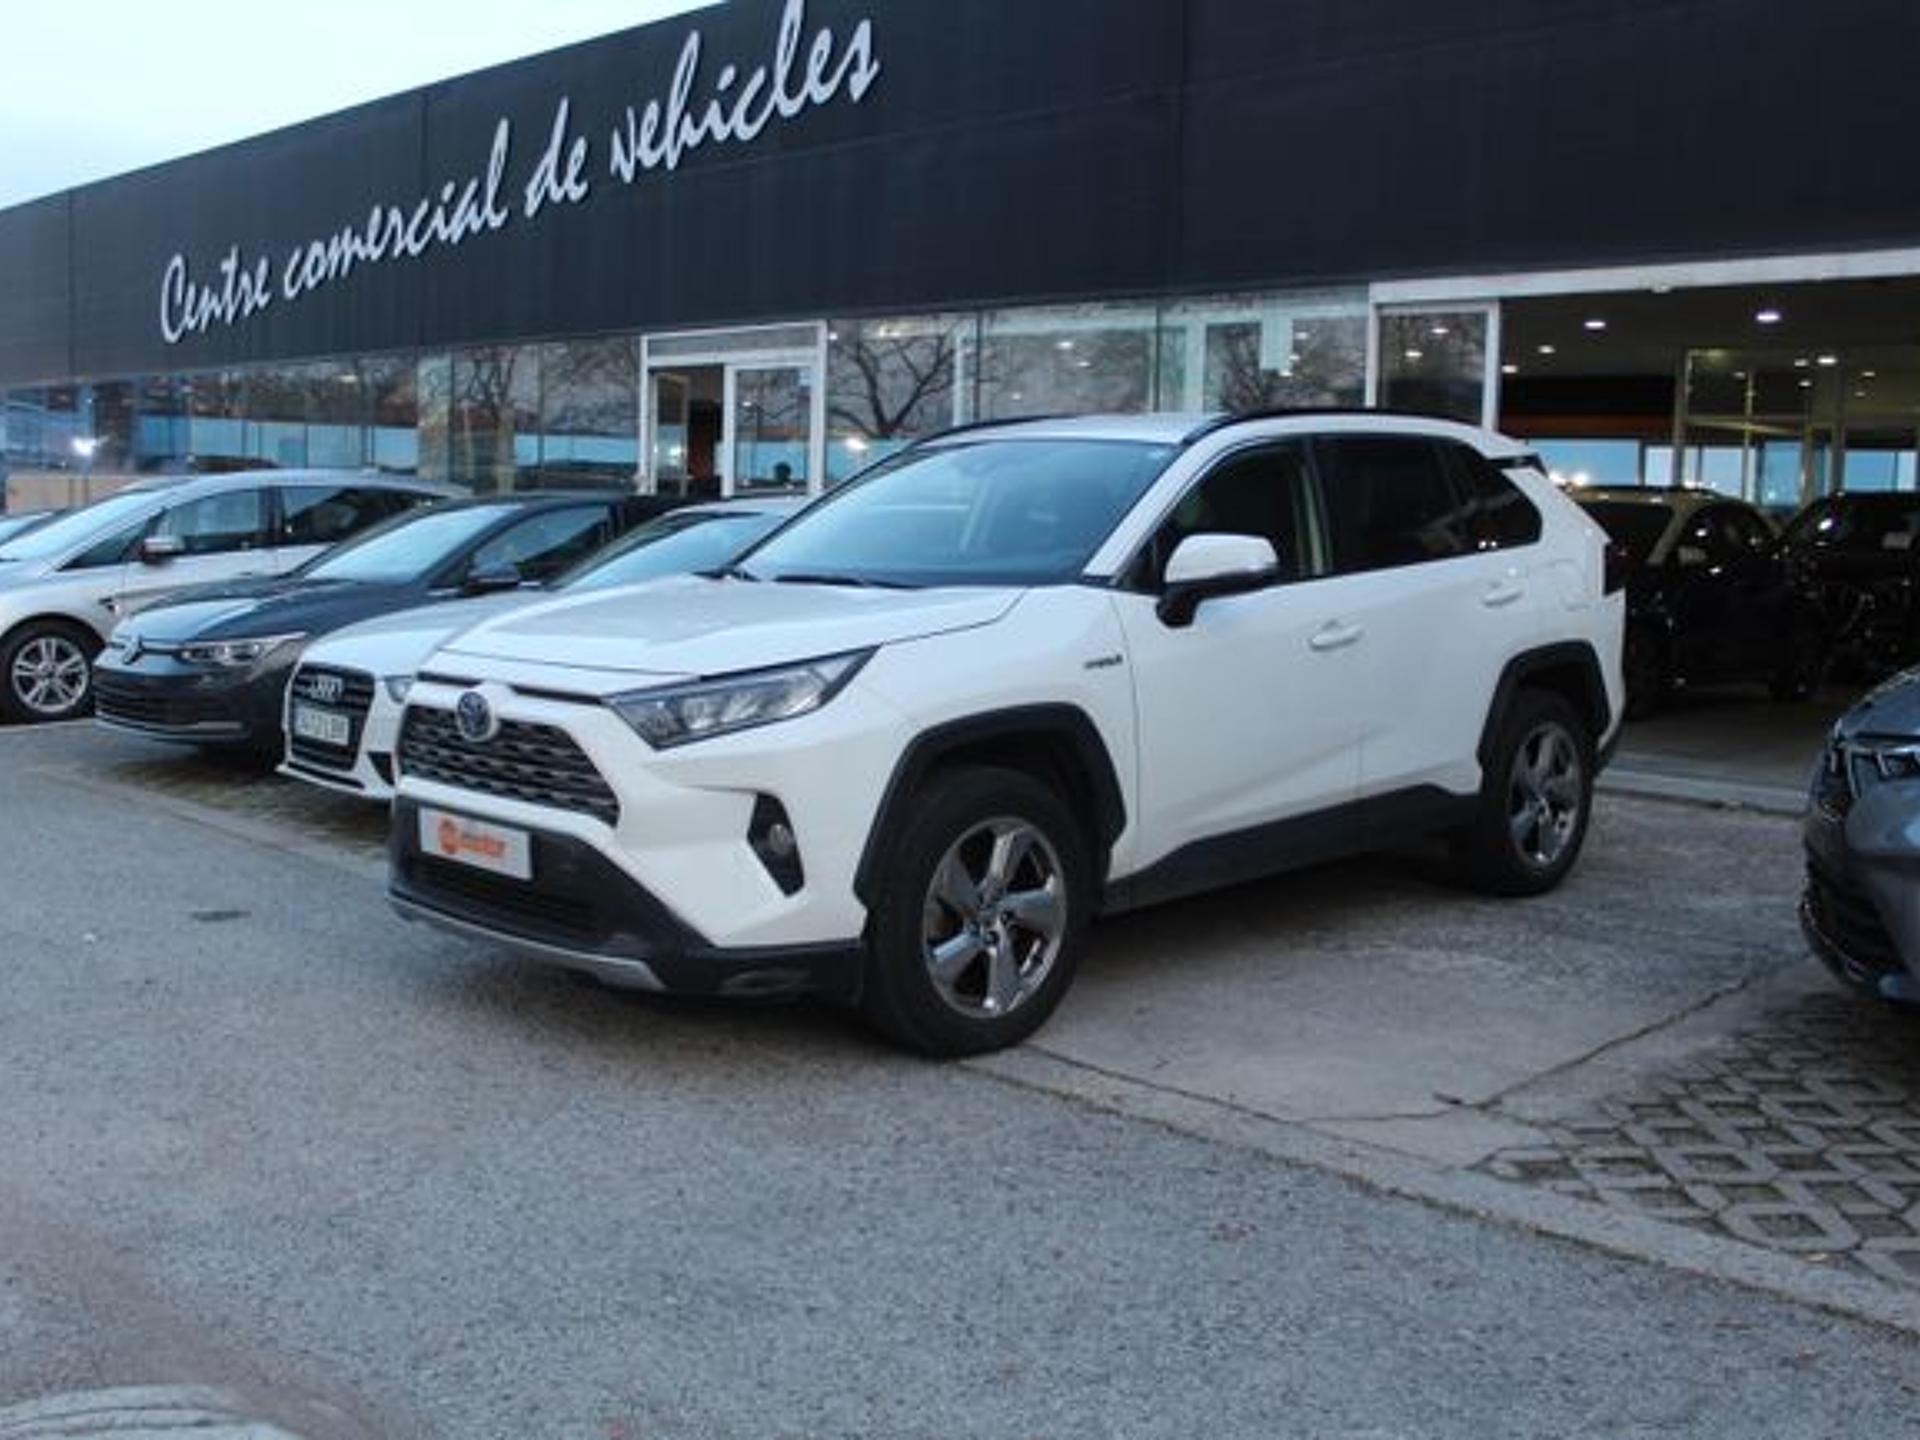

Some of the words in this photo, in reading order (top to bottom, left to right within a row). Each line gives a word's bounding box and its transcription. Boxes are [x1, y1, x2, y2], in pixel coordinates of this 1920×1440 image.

[161, 245, 271, 344] Centre
[283, 117, 509, 300] comercial
[525, 97, 589, 219] de
[610, 0, 880, 184] vehicles
